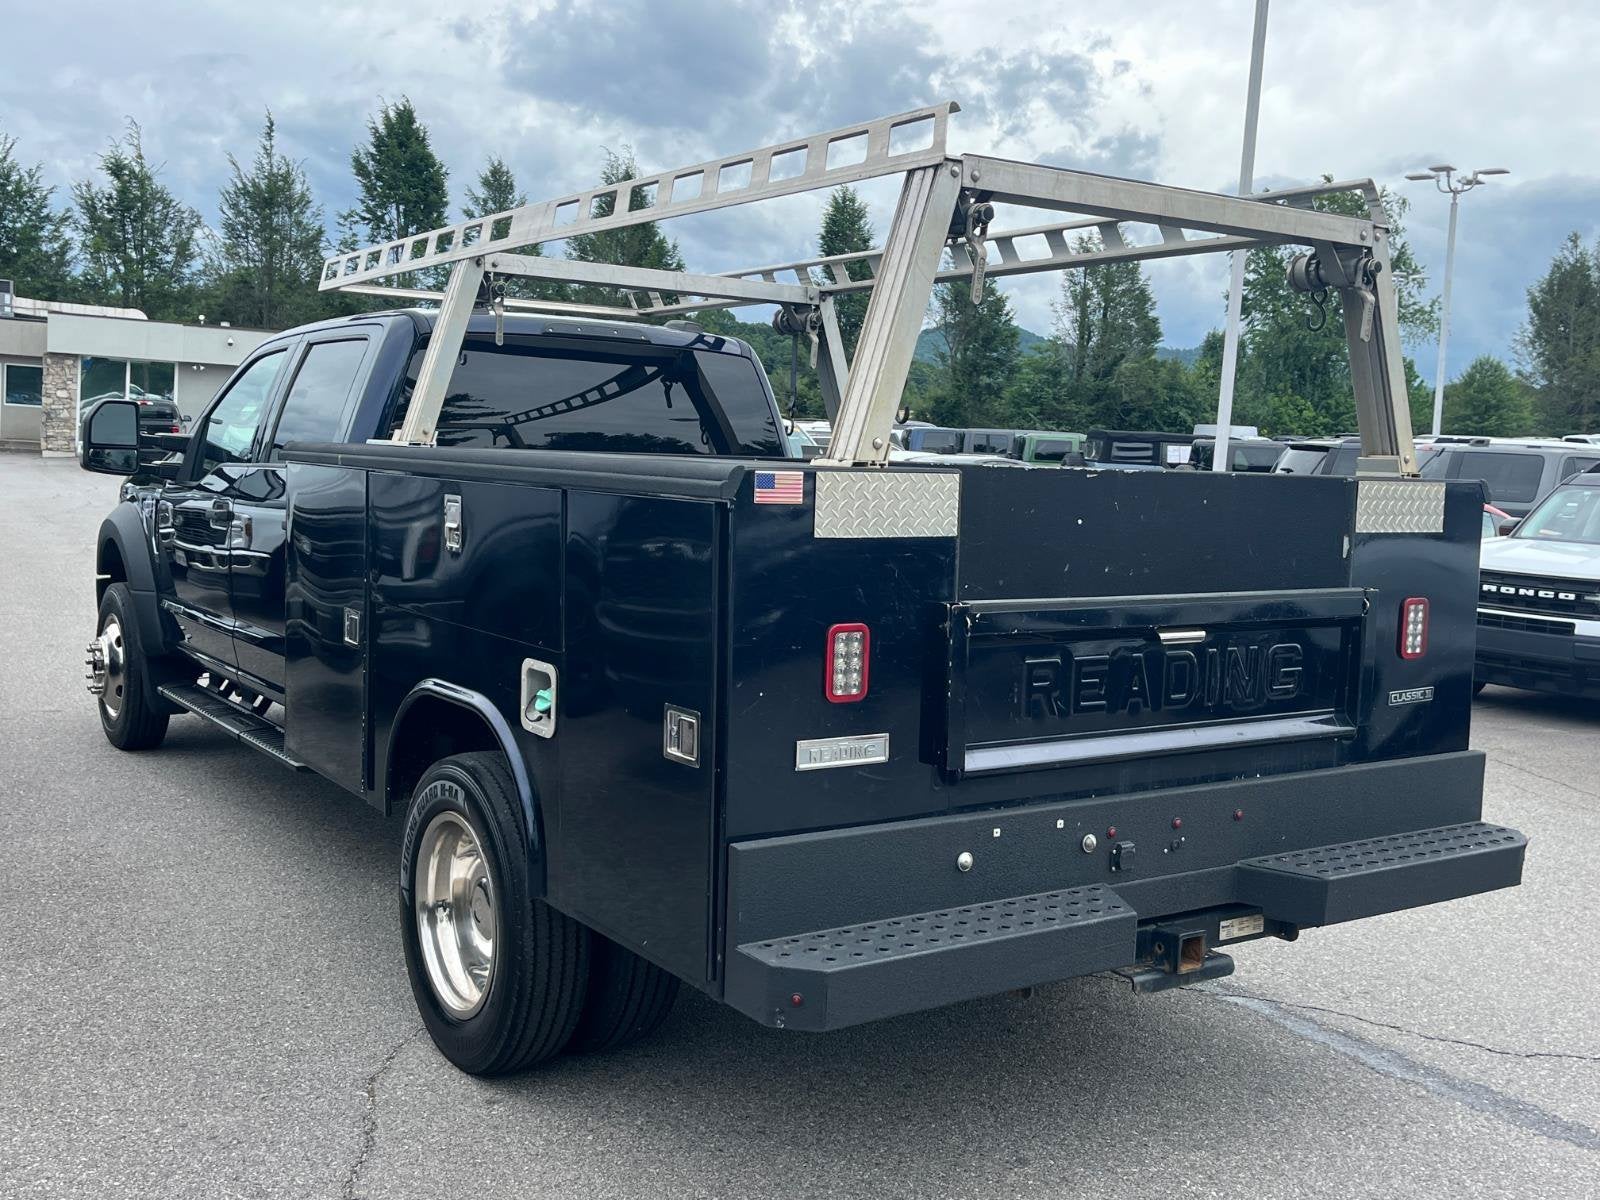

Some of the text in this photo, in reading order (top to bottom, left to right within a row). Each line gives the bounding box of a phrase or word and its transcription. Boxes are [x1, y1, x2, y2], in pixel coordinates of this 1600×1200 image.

[1482, 584, 1576, 601] RONCO
[1022, 643, 1304, 718] READING
[1392, 690, 1424, 703] CLASSIC
[402, 815, 417, 875] STRONG
[416, 784, 438, 815] GUARD
